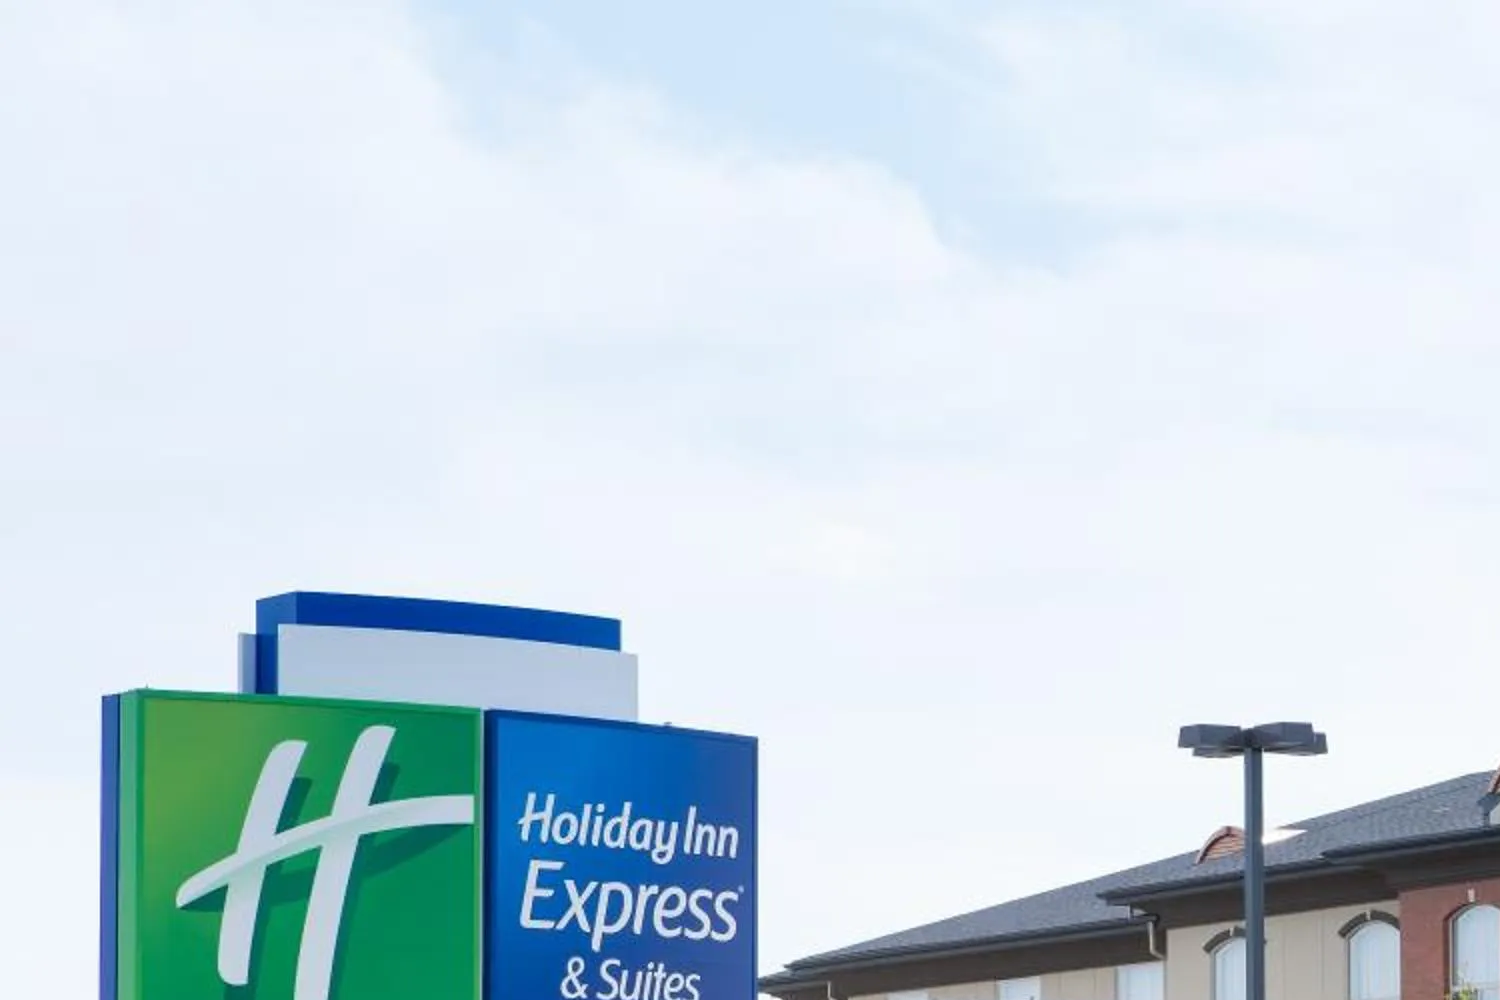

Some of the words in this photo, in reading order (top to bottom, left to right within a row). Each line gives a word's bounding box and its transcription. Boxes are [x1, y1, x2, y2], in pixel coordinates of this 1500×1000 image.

[517, 792, 678, 865] Holiday
[684, 805, 739, 859] Inn
[519, 859, 739, 952] Express
[560, 956, 588, 1000] &
